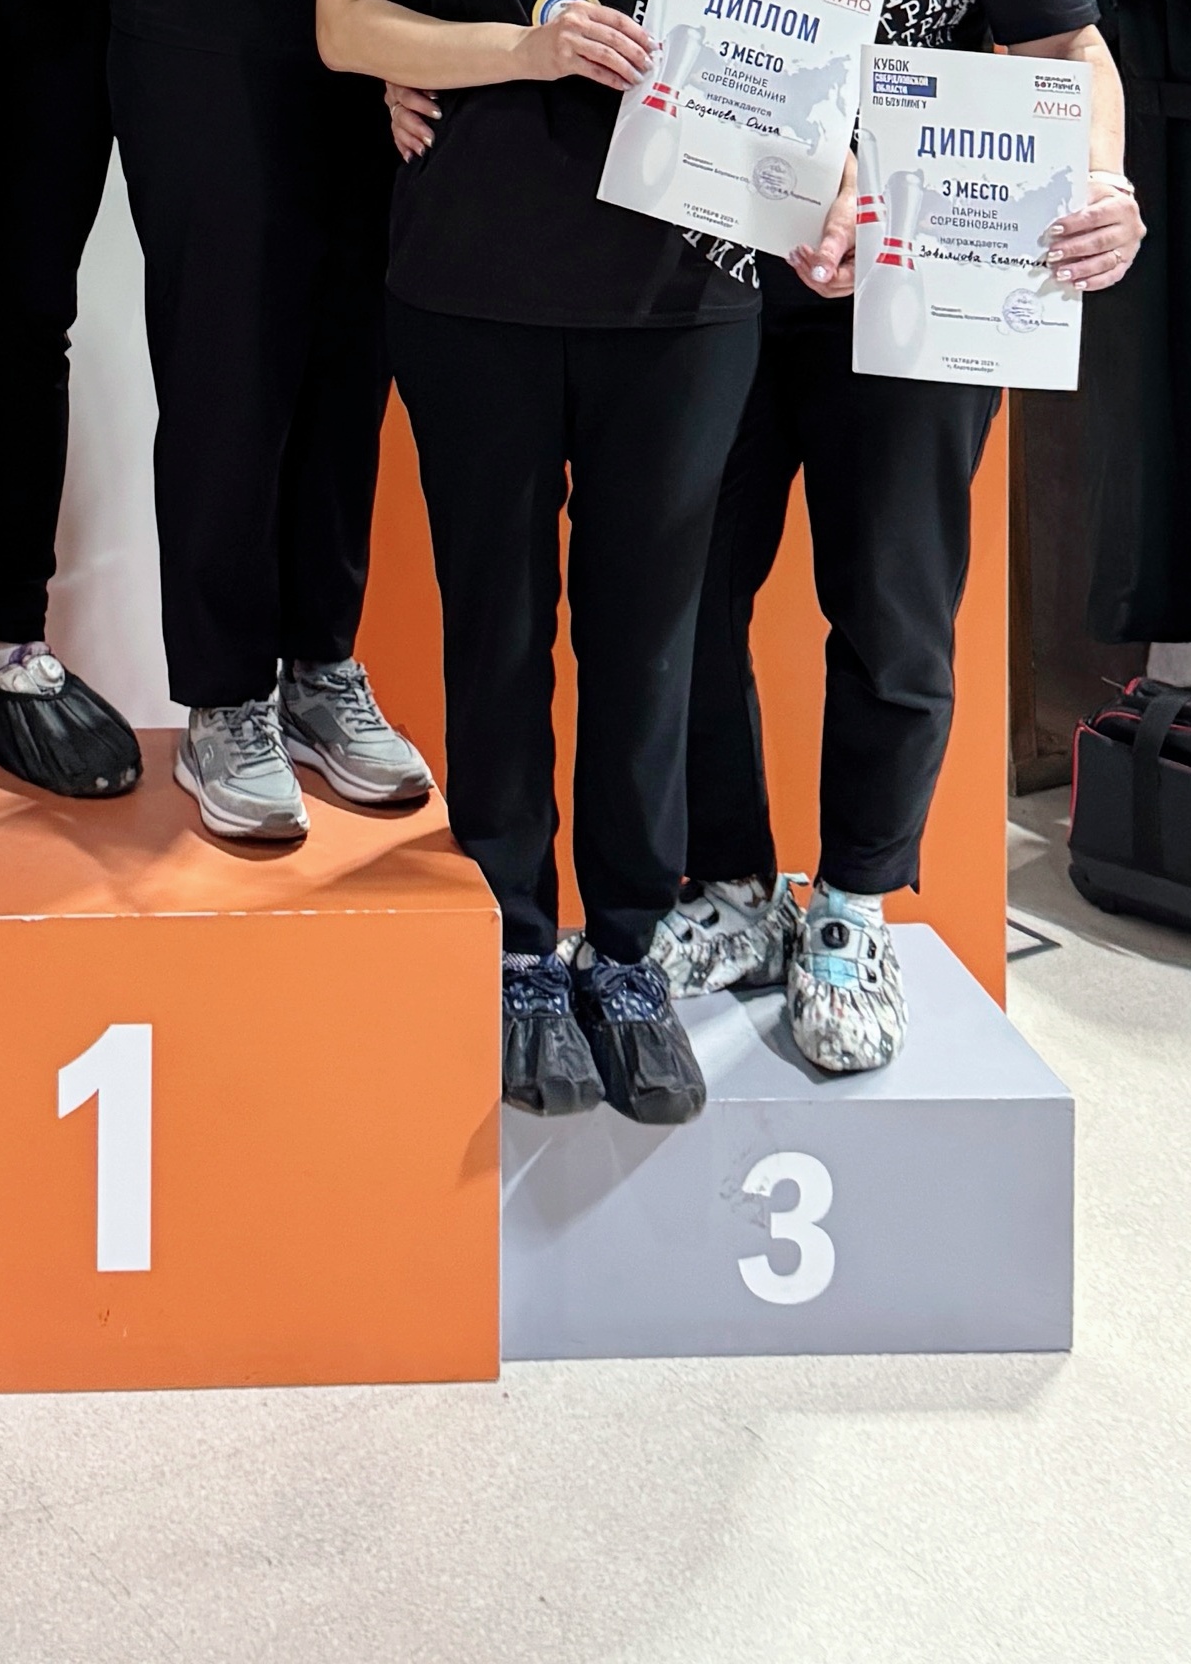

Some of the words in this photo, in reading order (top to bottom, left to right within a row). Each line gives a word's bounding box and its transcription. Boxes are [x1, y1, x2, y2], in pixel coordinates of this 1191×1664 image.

[720, 41, 729, 57] 3
[731, 44, 784, 73] МЕСТО
[874, 57, 909, 72] КУБОК
[702, 72, 786, 103] СОРЕВНОВАНИЯ
[724, 67, 768, 88] ПАРНЫЕ
[707, 93, 772, 117] награждается
[873, 96, 883, 106] ПО
[917, 126, 1035, 163] ДИПЛОМ
[942, 180, 951, 196] 3
[956, 181, 1009, 201] МЕСТО
[952, 207, 998, 219] ПАРНЫЕ
[930, 216, 1019, 232] СОРЕВНОВАНИЯ
[940, 237, 1008, 249] награждается
[58, 1023, 152, 1271] 1
[736, 1152, 835, 1305] 3
